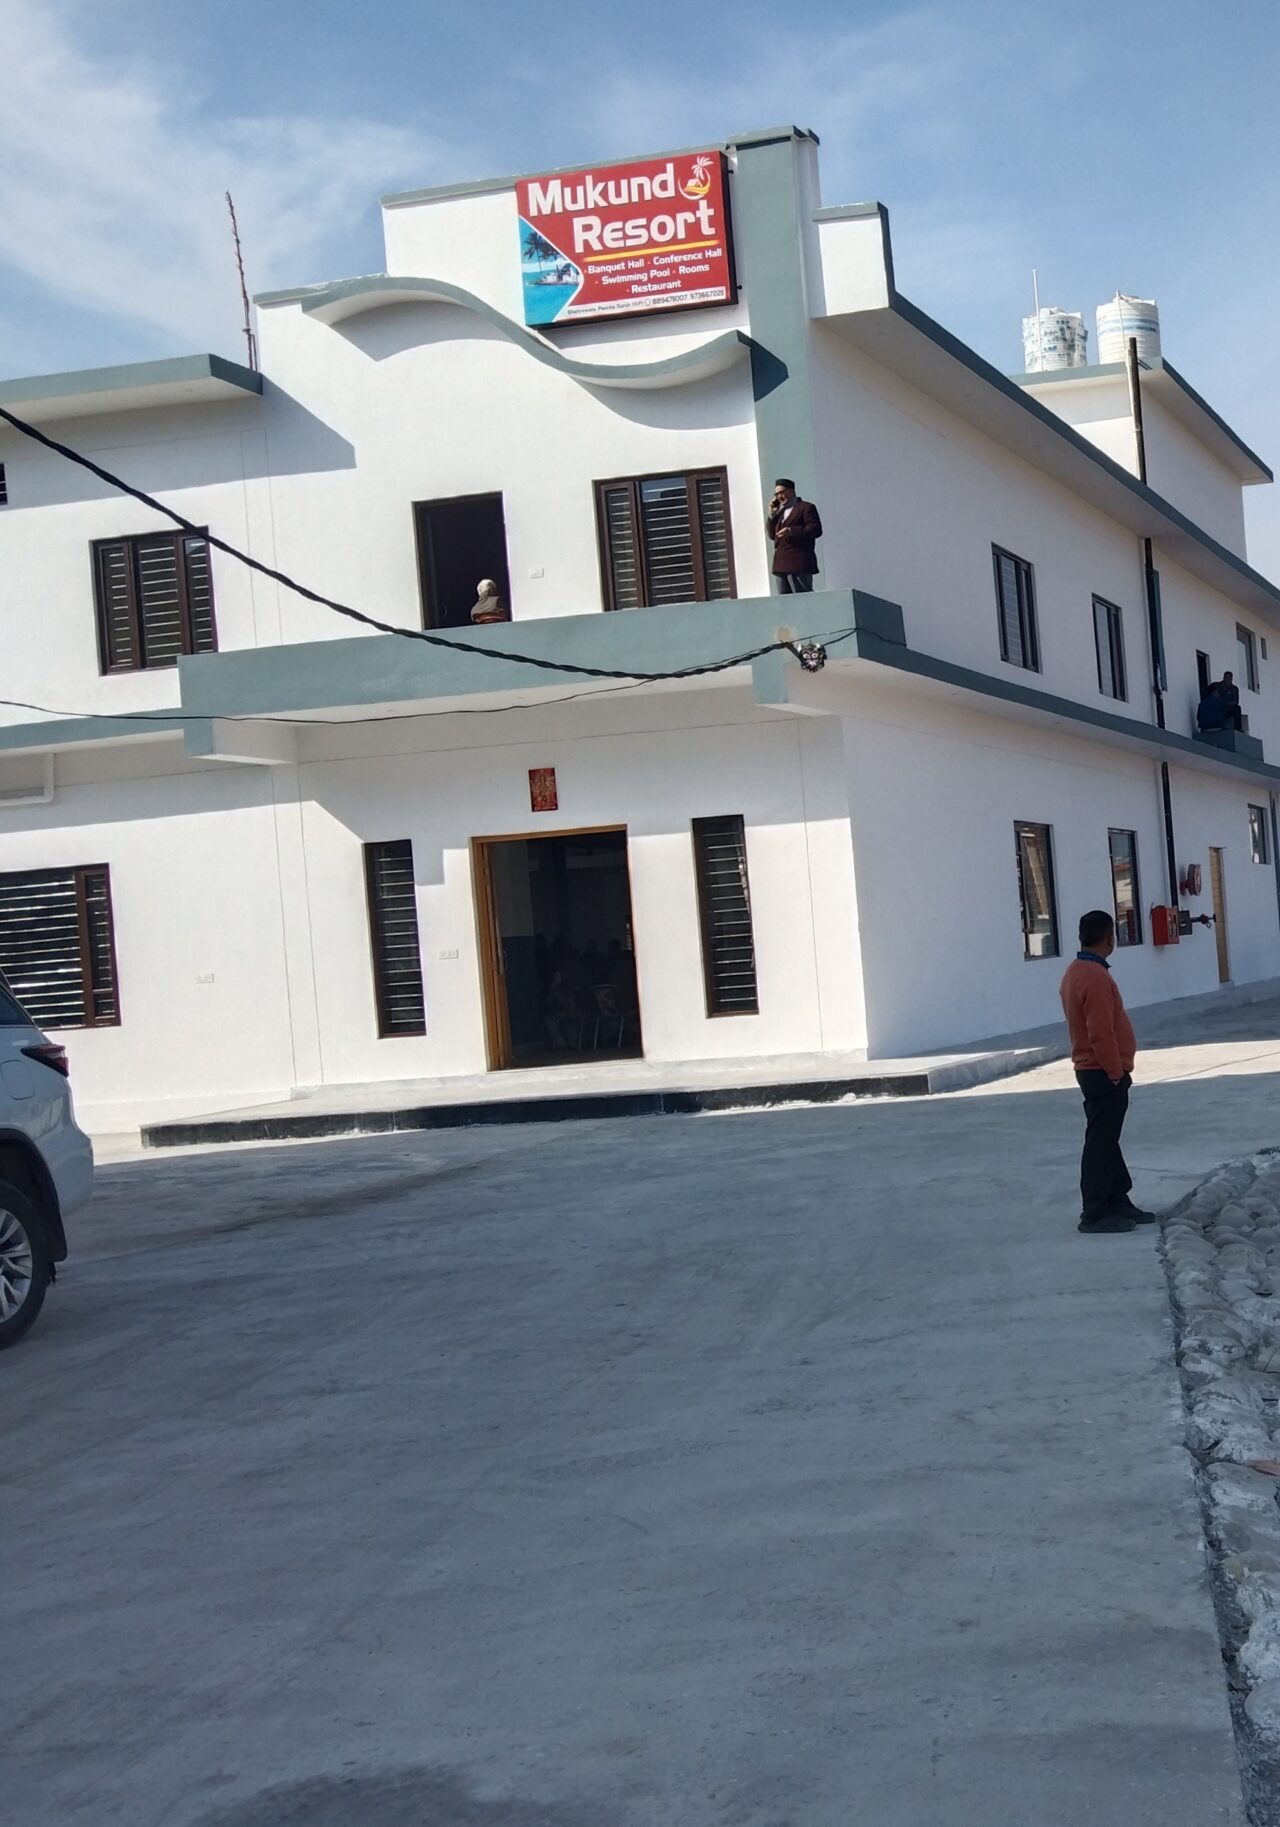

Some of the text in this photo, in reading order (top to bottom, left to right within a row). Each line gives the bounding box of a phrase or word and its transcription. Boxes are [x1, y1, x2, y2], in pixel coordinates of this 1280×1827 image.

[528, 163, 676, 217] Mukund
[573, 200, 716, 253] Resort
[588, 248, 722, 274] Banquet Hall Conference Hall
[602, 264, 710, 285] Swimming Pool Rooms
[631, 280, 682, 294] Restaurant
